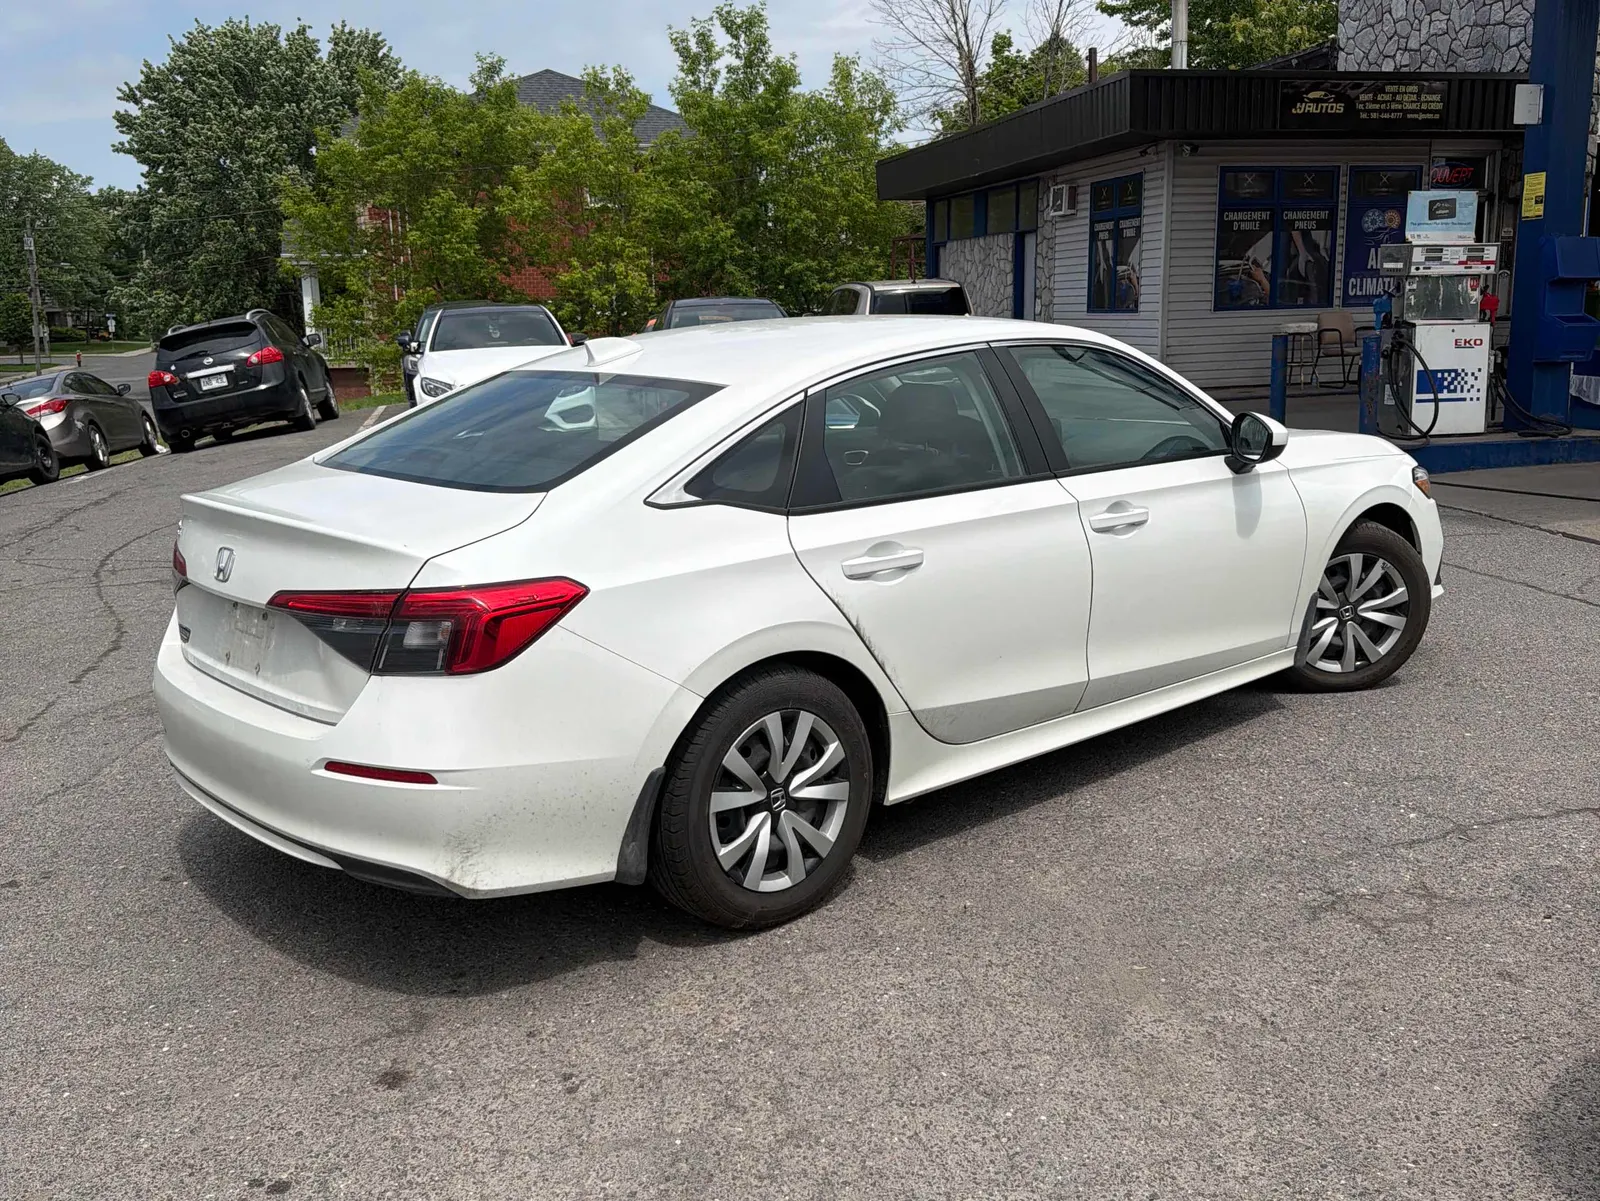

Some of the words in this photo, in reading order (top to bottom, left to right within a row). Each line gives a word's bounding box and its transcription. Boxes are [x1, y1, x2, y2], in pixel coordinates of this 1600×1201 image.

[1430, 166, 1475, 183] OUVERT
[1223, 211, 1271, 221] CHANGEMENT
[1283, 210, 1329, 220] CHANGEMENT
[1233, 221, 1260, 231] D'HUILE
[1294, 221, 1317, 230] PNEUS
[1454, 338, 1483, 347] EKO
